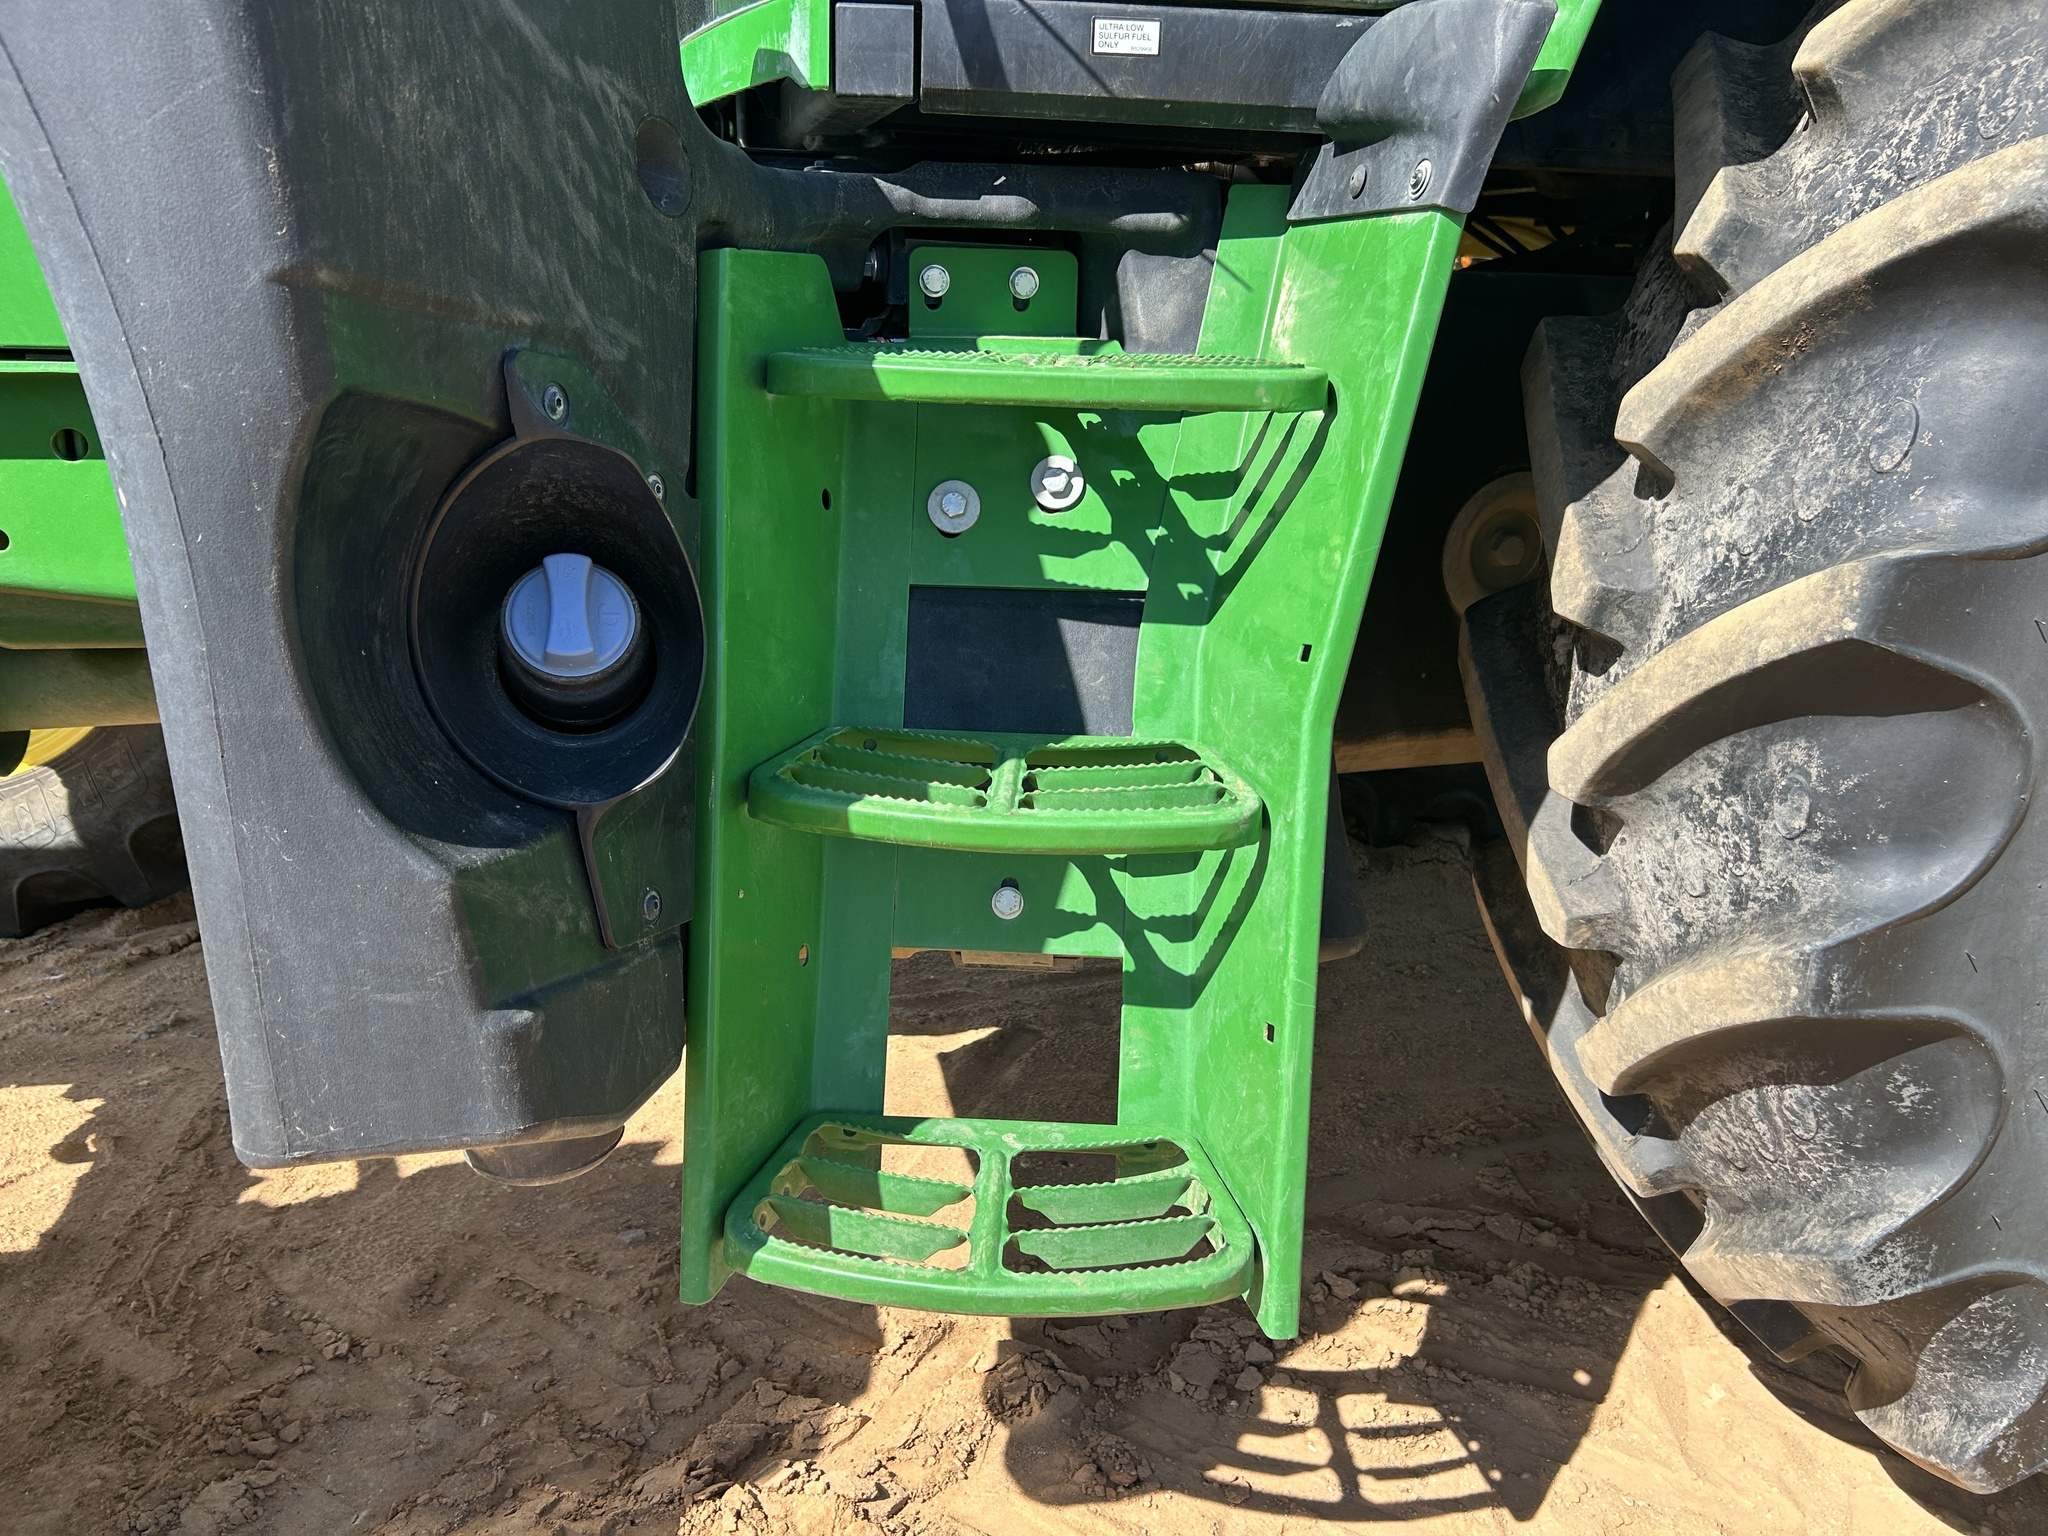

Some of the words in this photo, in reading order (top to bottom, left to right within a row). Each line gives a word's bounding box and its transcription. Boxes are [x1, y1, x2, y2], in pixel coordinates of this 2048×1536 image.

[1098, 23, 1124, 31] ULTRA
[1098, 31, 1130, 40] SULFUR
[1131, 33, 1152, 41] FUEL
[1098, 40, 1119, 49] ONLY
